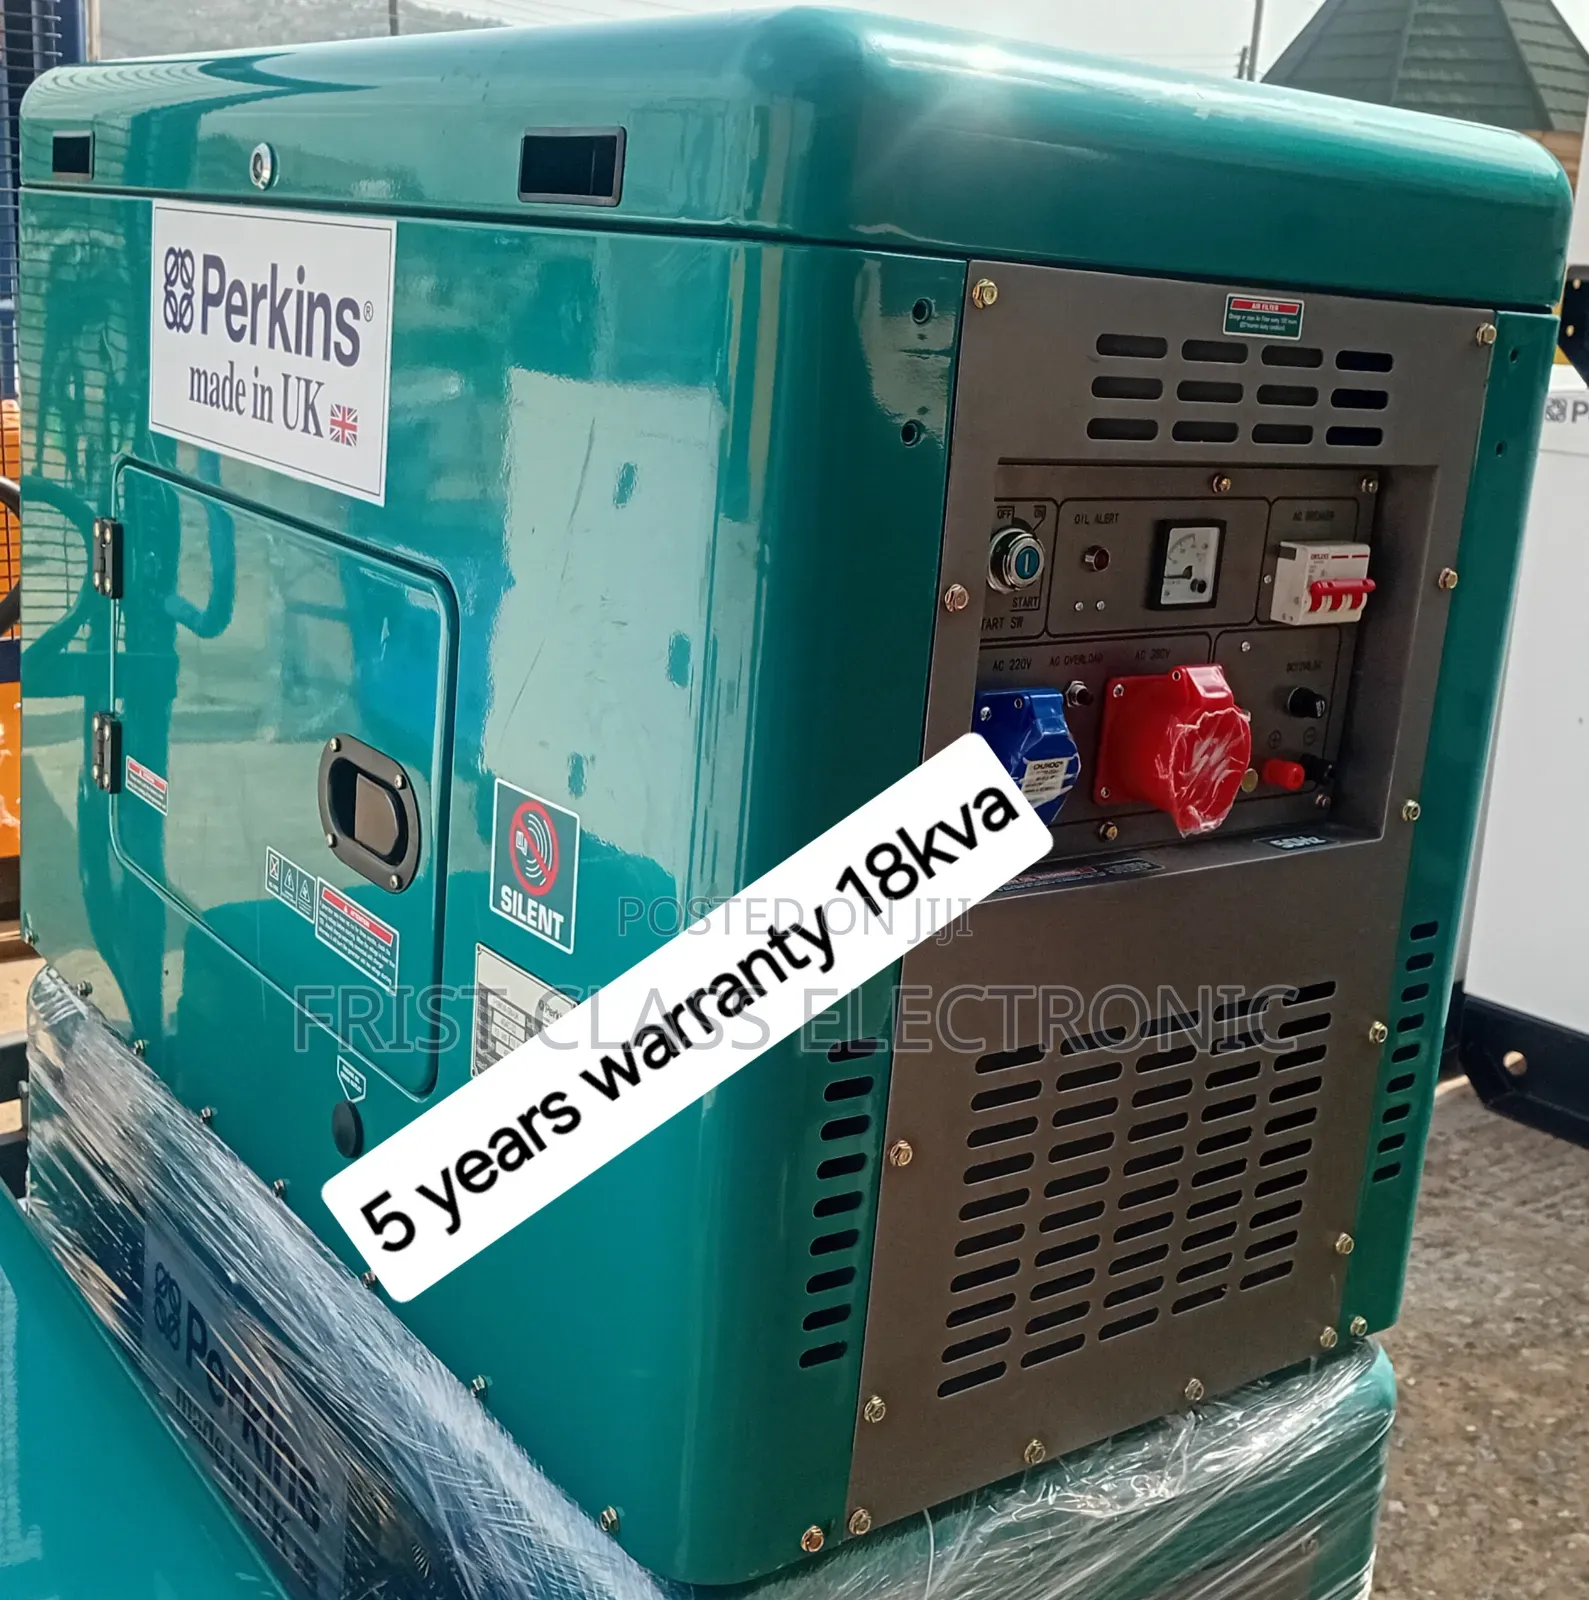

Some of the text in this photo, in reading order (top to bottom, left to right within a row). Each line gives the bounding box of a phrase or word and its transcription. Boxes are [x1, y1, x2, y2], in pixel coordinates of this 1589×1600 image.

[1251, 302, 1279, 311] AIR FILTER
[189, 360, 325, 438] made in UK
[1571, 399, 1589, 424] P
[997, 508, 1046, 520] OFF ON
[1074, 512, 1120, 526] OIL ALERT
[1012, 596, 1038, 609] START
[981, 615, 1024, 631] TART SW
[1049, 652, 1104, 667] AC OVERLOAD
[1134, 649, 1146, 661] AC
[992, 657, 1032, 672] AC 220V
[500, 884, 564, 941] SILENT
